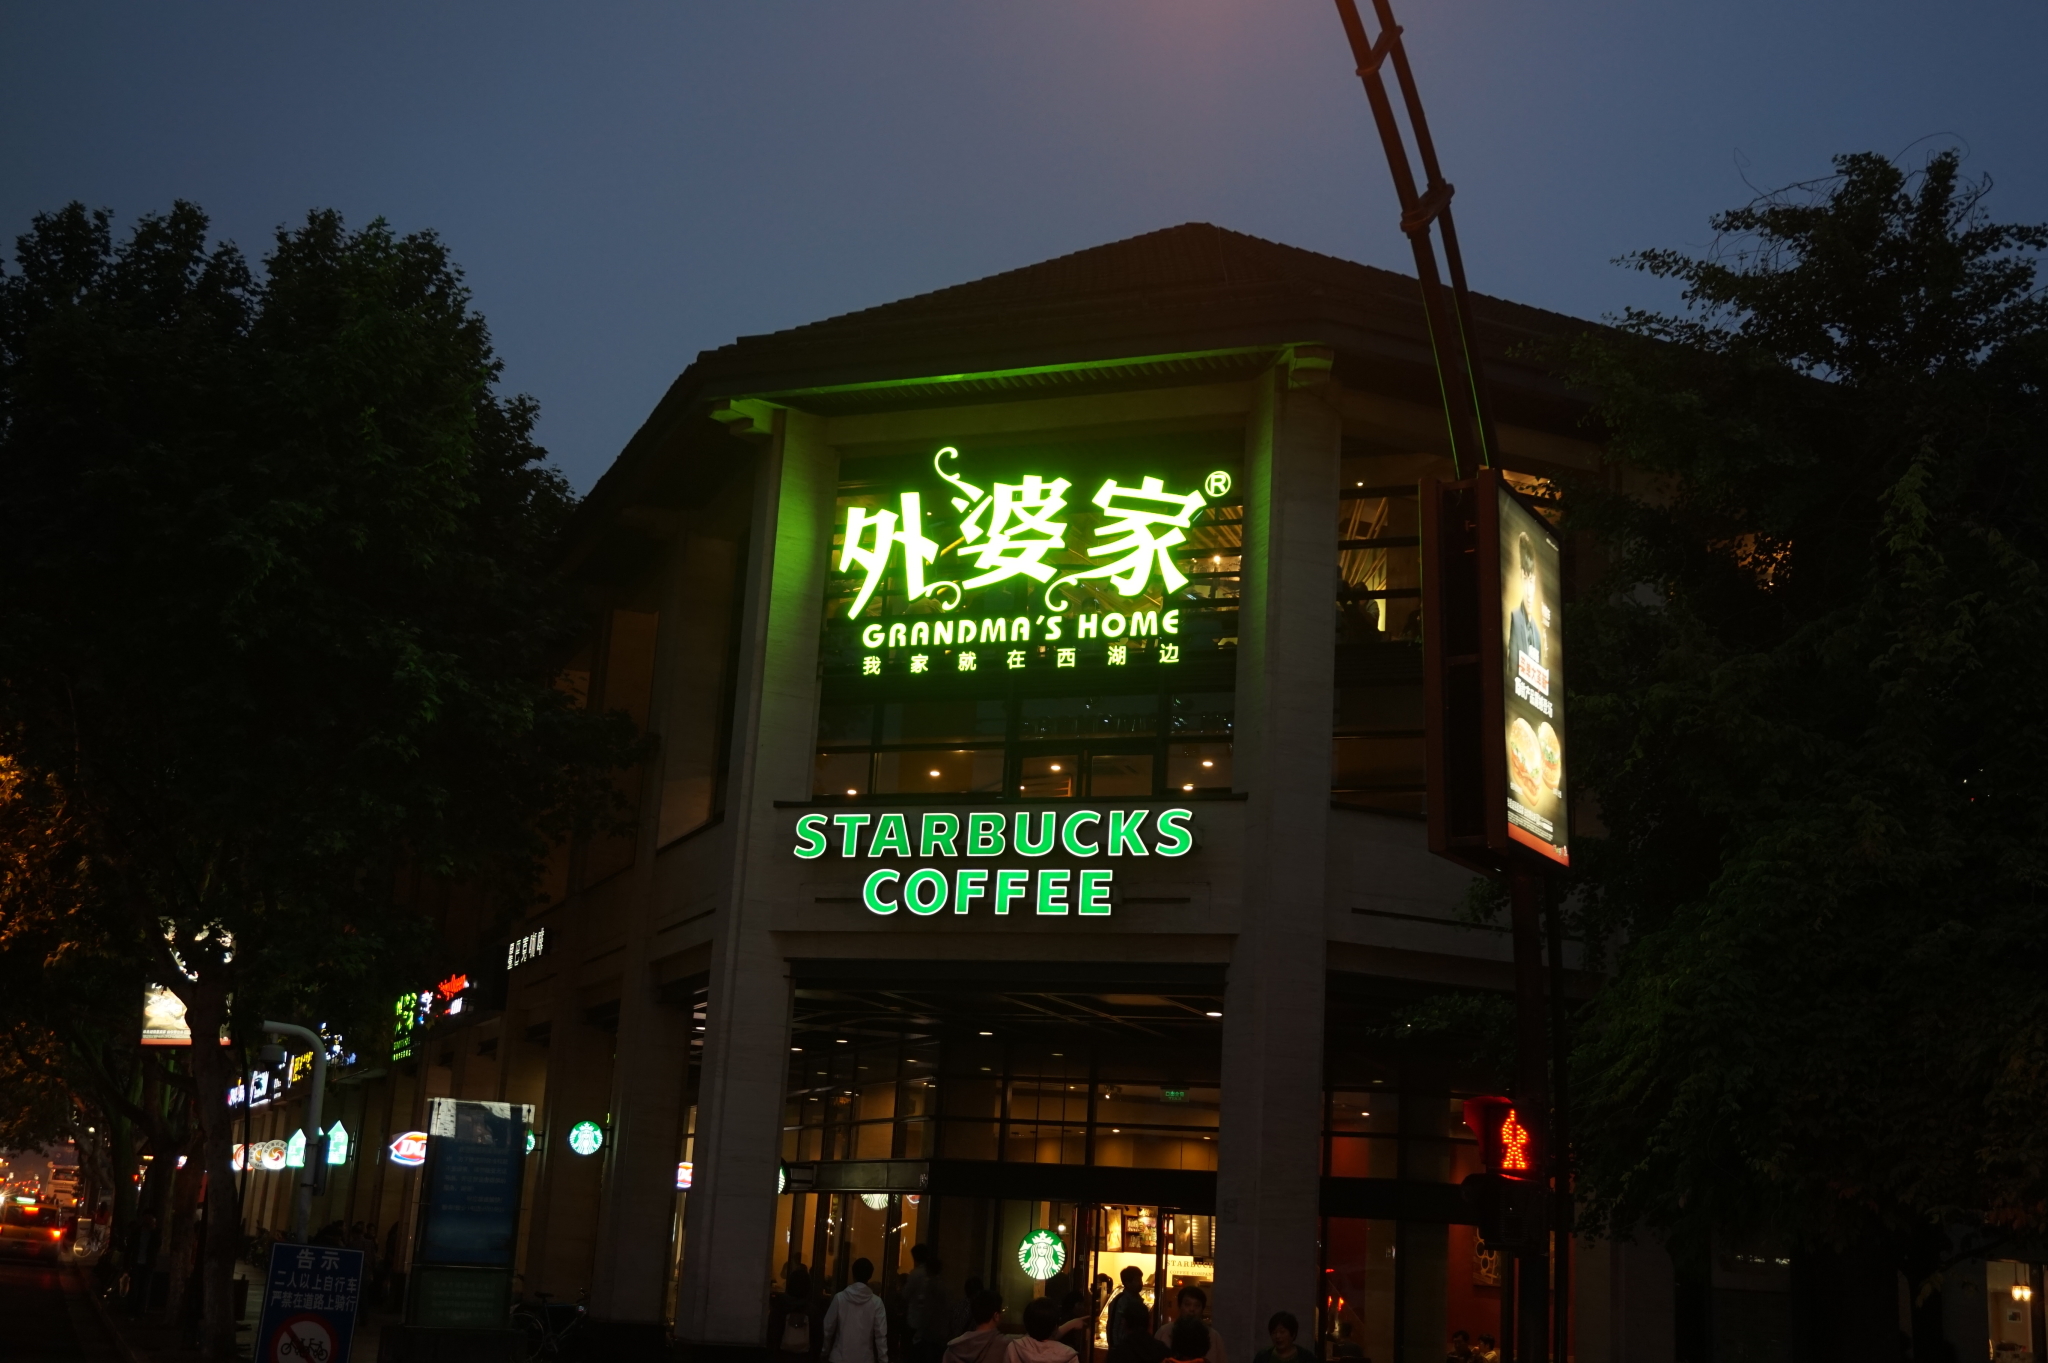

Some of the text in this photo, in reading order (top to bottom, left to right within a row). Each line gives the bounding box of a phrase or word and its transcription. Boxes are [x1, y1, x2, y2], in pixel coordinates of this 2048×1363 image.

[839, 446, 1207, 620] 外婆家
[862, 609, 1180, 649] GRANDMA'S HOME
[862, 643, 1180, 676] 我家就在西湖边
[793, 808, 1193, 860] STARBUCKS
[863, 867, 1113, 916] COFFEE
[296, 1248, 341, 1271] 告示
[274, 1269, 358, 1294] 二人以上自行车
[271, 1290, 357, 1313] 严禁在道路上骑行
